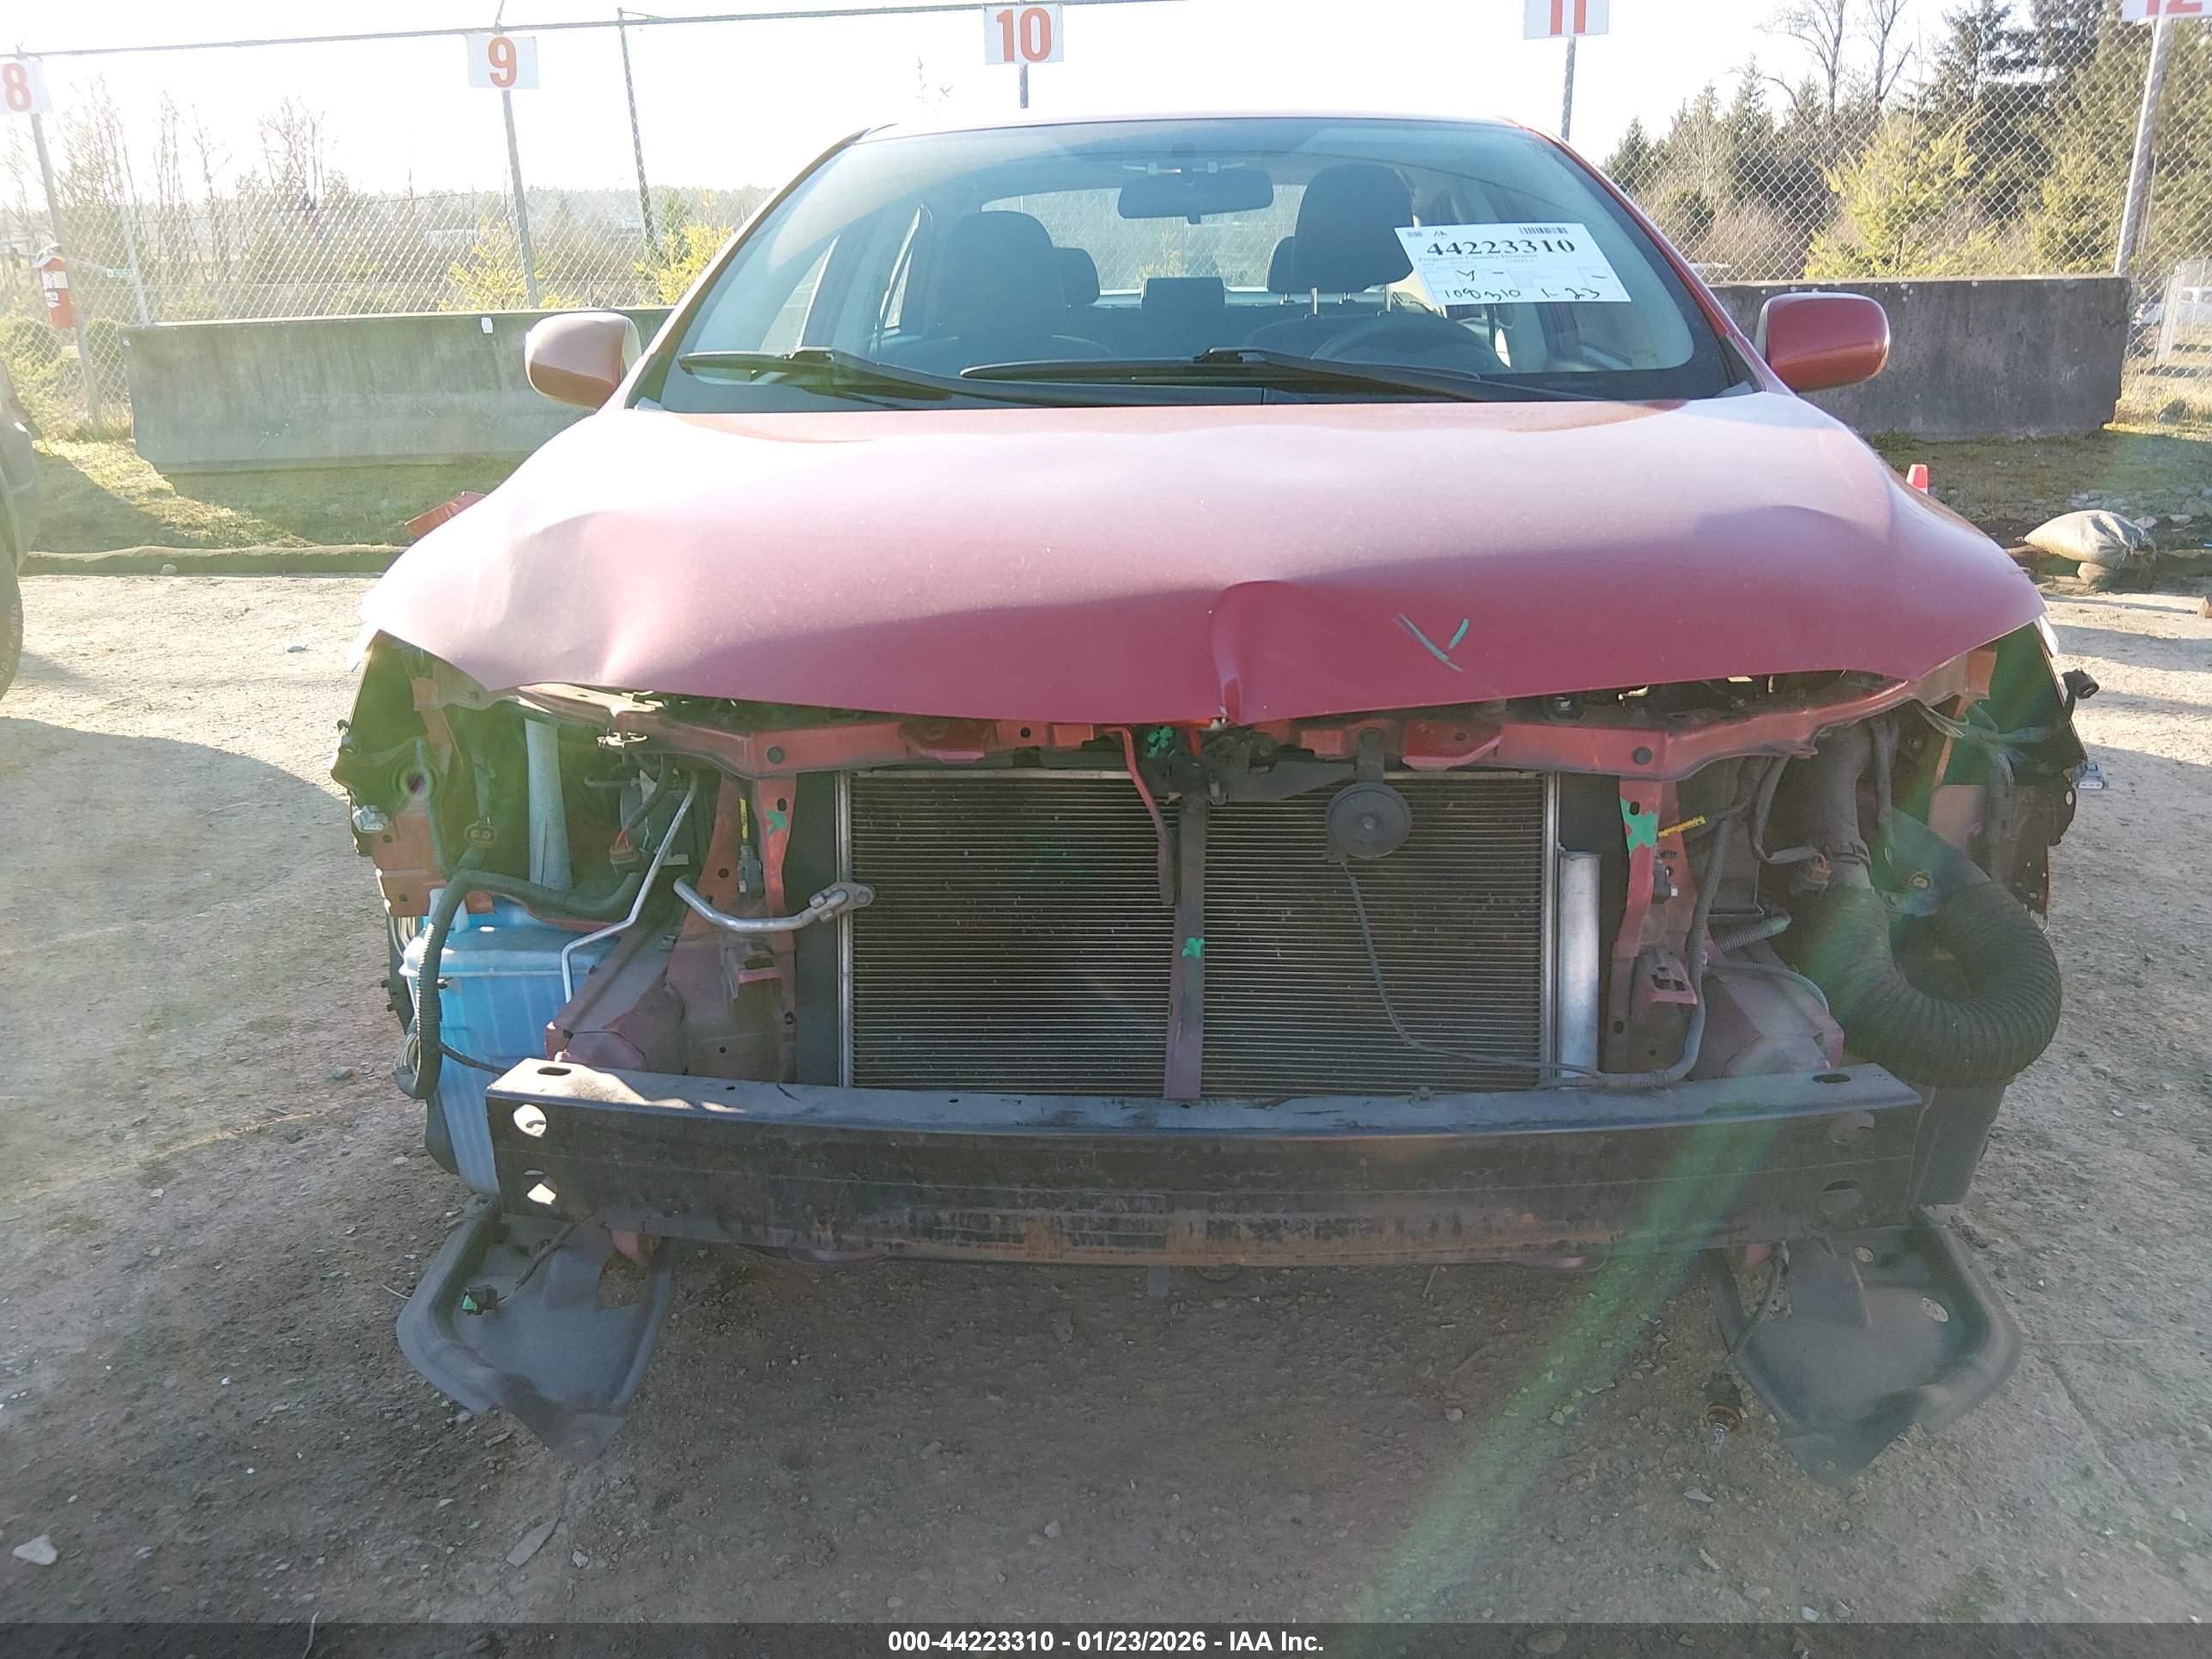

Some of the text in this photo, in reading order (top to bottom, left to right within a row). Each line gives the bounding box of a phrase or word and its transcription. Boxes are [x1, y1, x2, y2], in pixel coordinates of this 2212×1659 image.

[996, 8, 1052, 62] 10
[3, 63, 32, 111] 8
[488, 36, 517, 88] 9
[1426, 238, 1576, 256] 44223310
